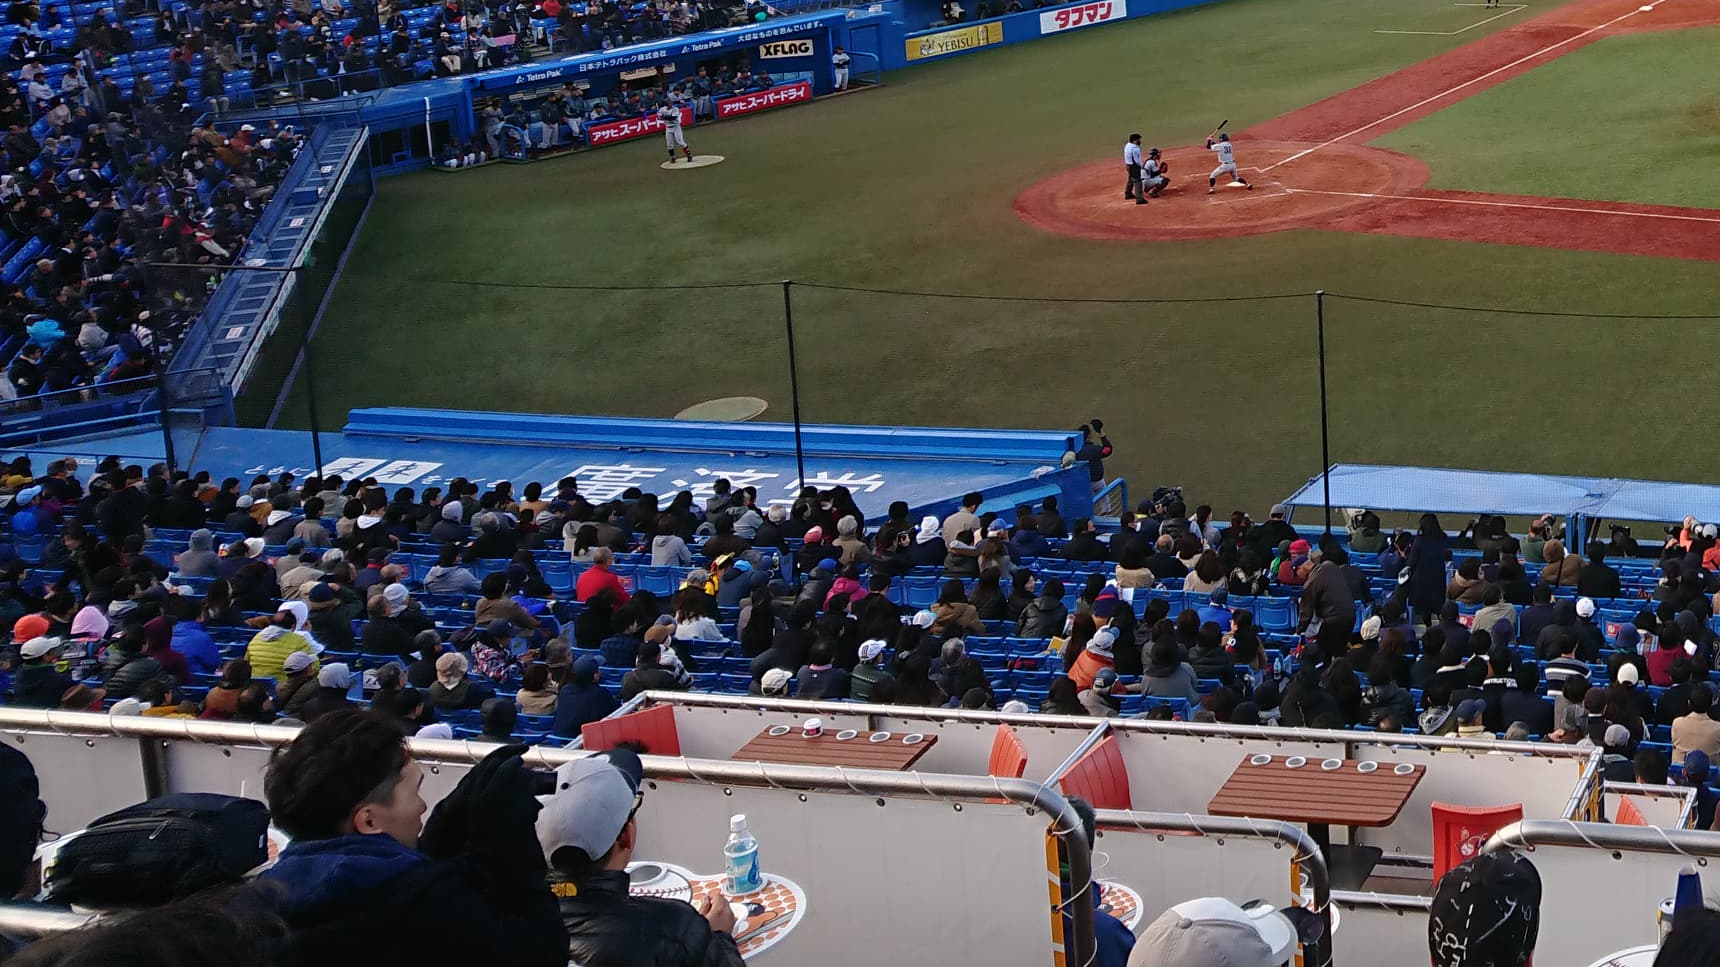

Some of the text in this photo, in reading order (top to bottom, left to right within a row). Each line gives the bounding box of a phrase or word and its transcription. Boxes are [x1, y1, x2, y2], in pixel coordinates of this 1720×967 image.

[1054, 2, 1113, 29] タフマン
[691, 43, 708, 52] Tetra
[937, 36, 974, 53] YEBISU
[579, 50, 668, 72] 日本テトラパック株式会社
